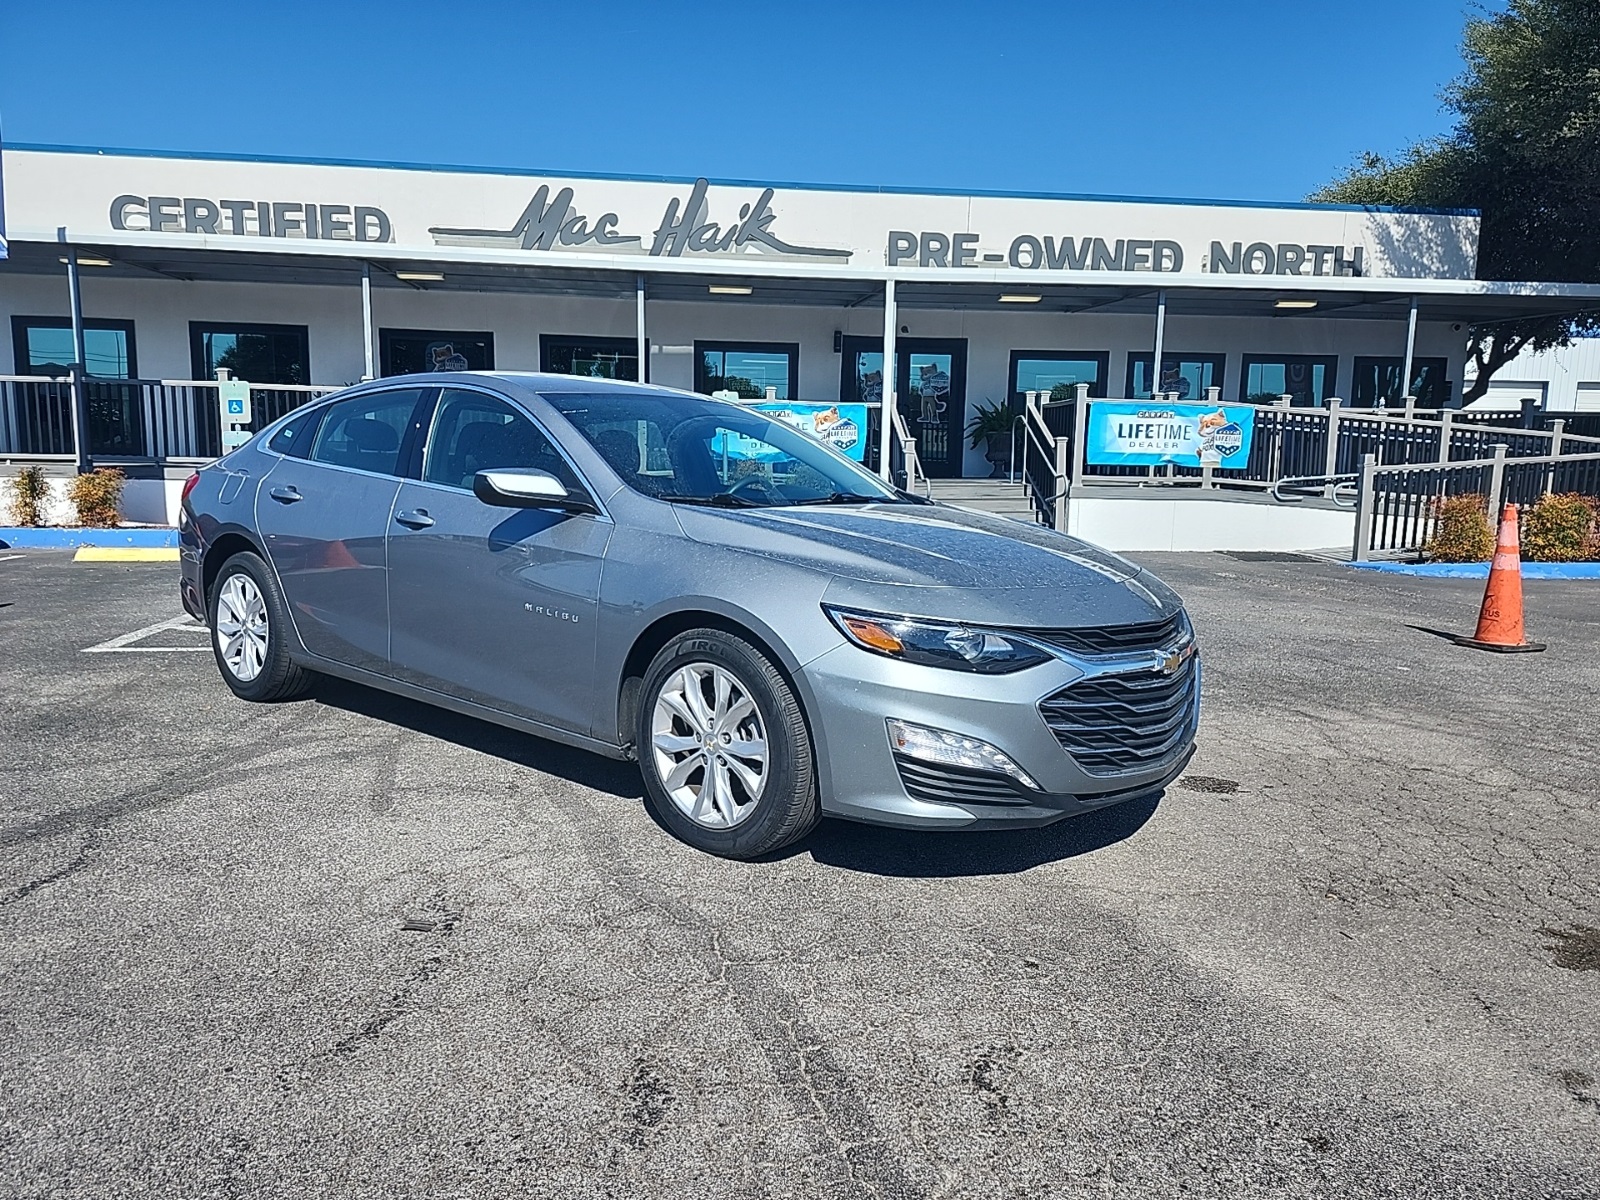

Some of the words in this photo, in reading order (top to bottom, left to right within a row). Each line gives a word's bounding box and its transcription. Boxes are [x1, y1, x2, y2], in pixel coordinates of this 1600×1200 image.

[110, 194, 391, 243] CERTIFIED
[428, 184, 641, 251] Mac
[649, 178, 853, 257] Haik
[888, 231, 1184, 272] PRE-OWNED
[1210, 241, 1364, 277] NORTH
[1137, 410, 1175, 419] CARFAX
[1118, 422, 1192, 441] LIFETIME
[1129, 441, 1179, 449] DEALER
[524, 602, 579, 623] MALIBU
